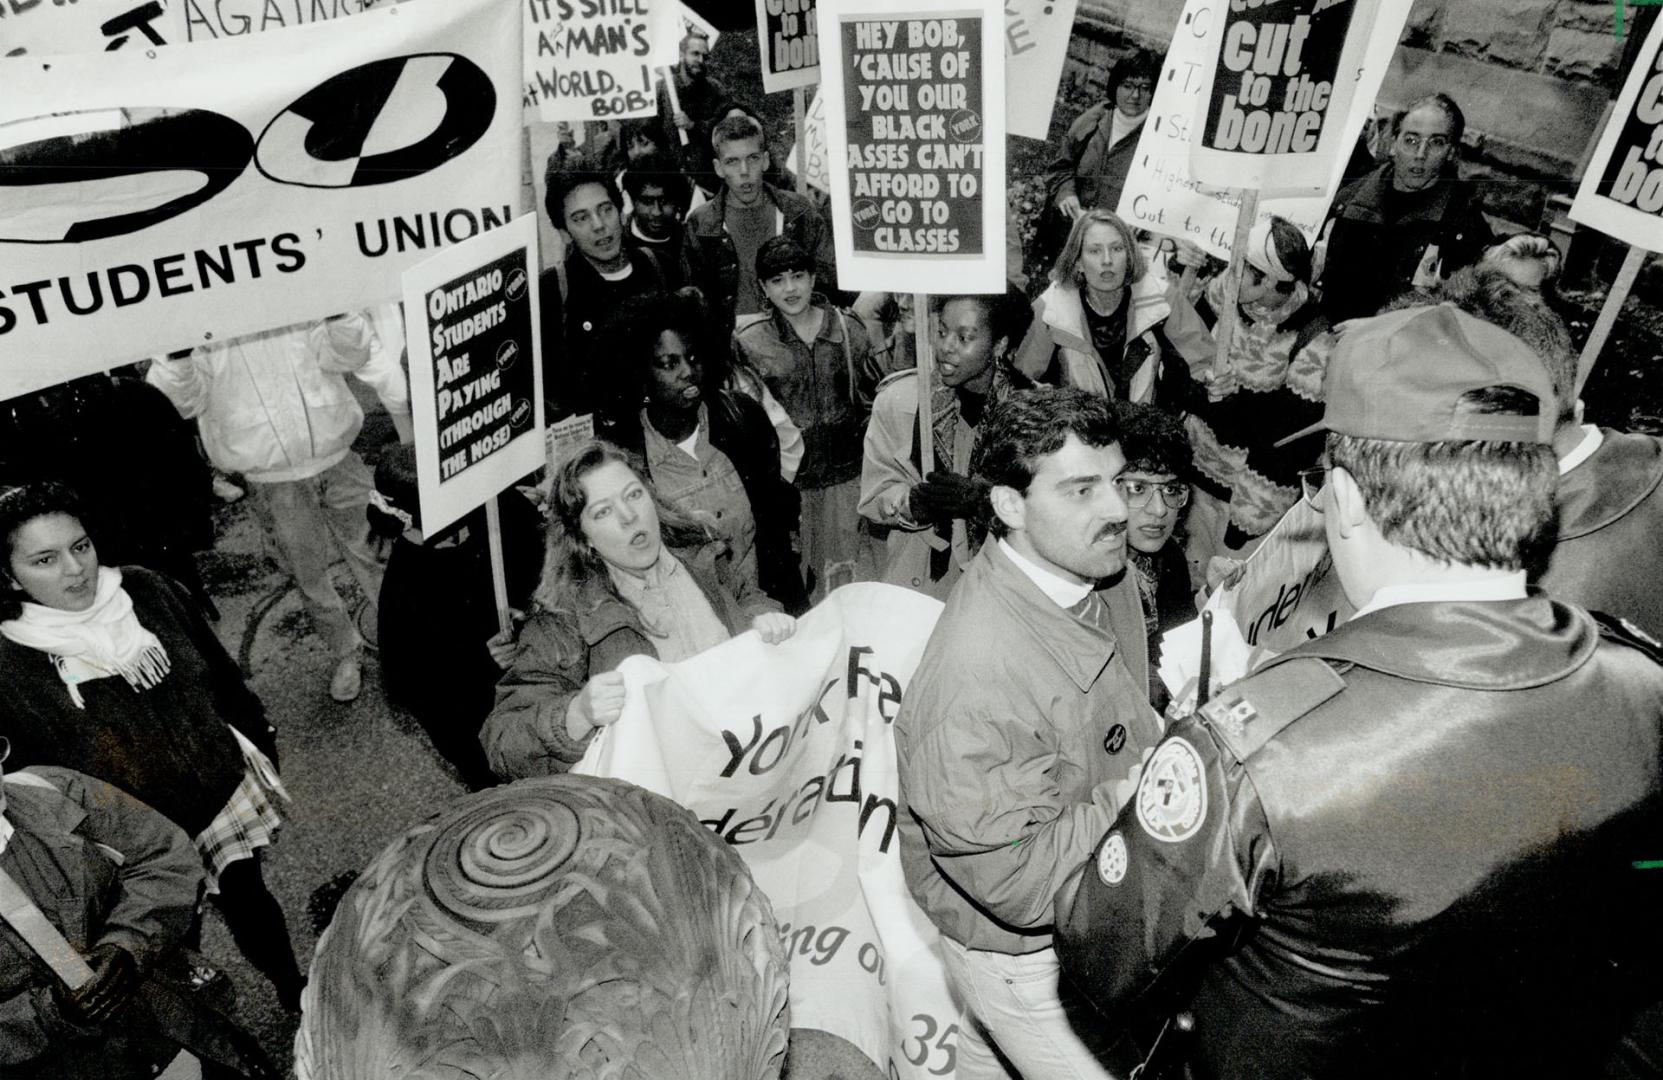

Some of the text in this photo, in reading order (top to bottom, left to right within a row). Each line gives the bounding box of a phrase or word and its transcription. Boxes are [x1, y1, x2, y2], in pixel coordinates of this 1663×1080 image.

[538, 31, 555, 57] A
[565, 18, 650, 58] MAN'S
[775, 31, 817, 71] bon
[855, 19, 966, 49] HEY BOB,
[1223, 15, 1311, 77] cut
[536, 65, 624, 99] WORLD,
[853, 52, 970, 80] 'CAUSE OF
[858, 83, 967, 111] YOU OUR
[1239, 70, 1272, 106] to
[1283, 74, 1332, 112] the
[872, 115, 946, 139] BLACK
[1213, 94, 1321, 154] bone
[847, 144, 984, 169] ASSES CAN'T
[854, 173, 977, 198] AFFORD TO
[881, 200, 949, 224] GO TO
[1133, 194, 1165, 224] Cut
[874, 227, 960, 252] CLASSES
[429, 269, 503, 321] ONTARIO
[433, 301, 507, 356] STUDENTS
[436, 352, 471, 390] ARE
[438, 369, 501, 421] PAYING
[440, 392, 512, 450] (THROUGH
[441, 449, 467, 479] THE
[471, 424, 511, 463] NOSE)
